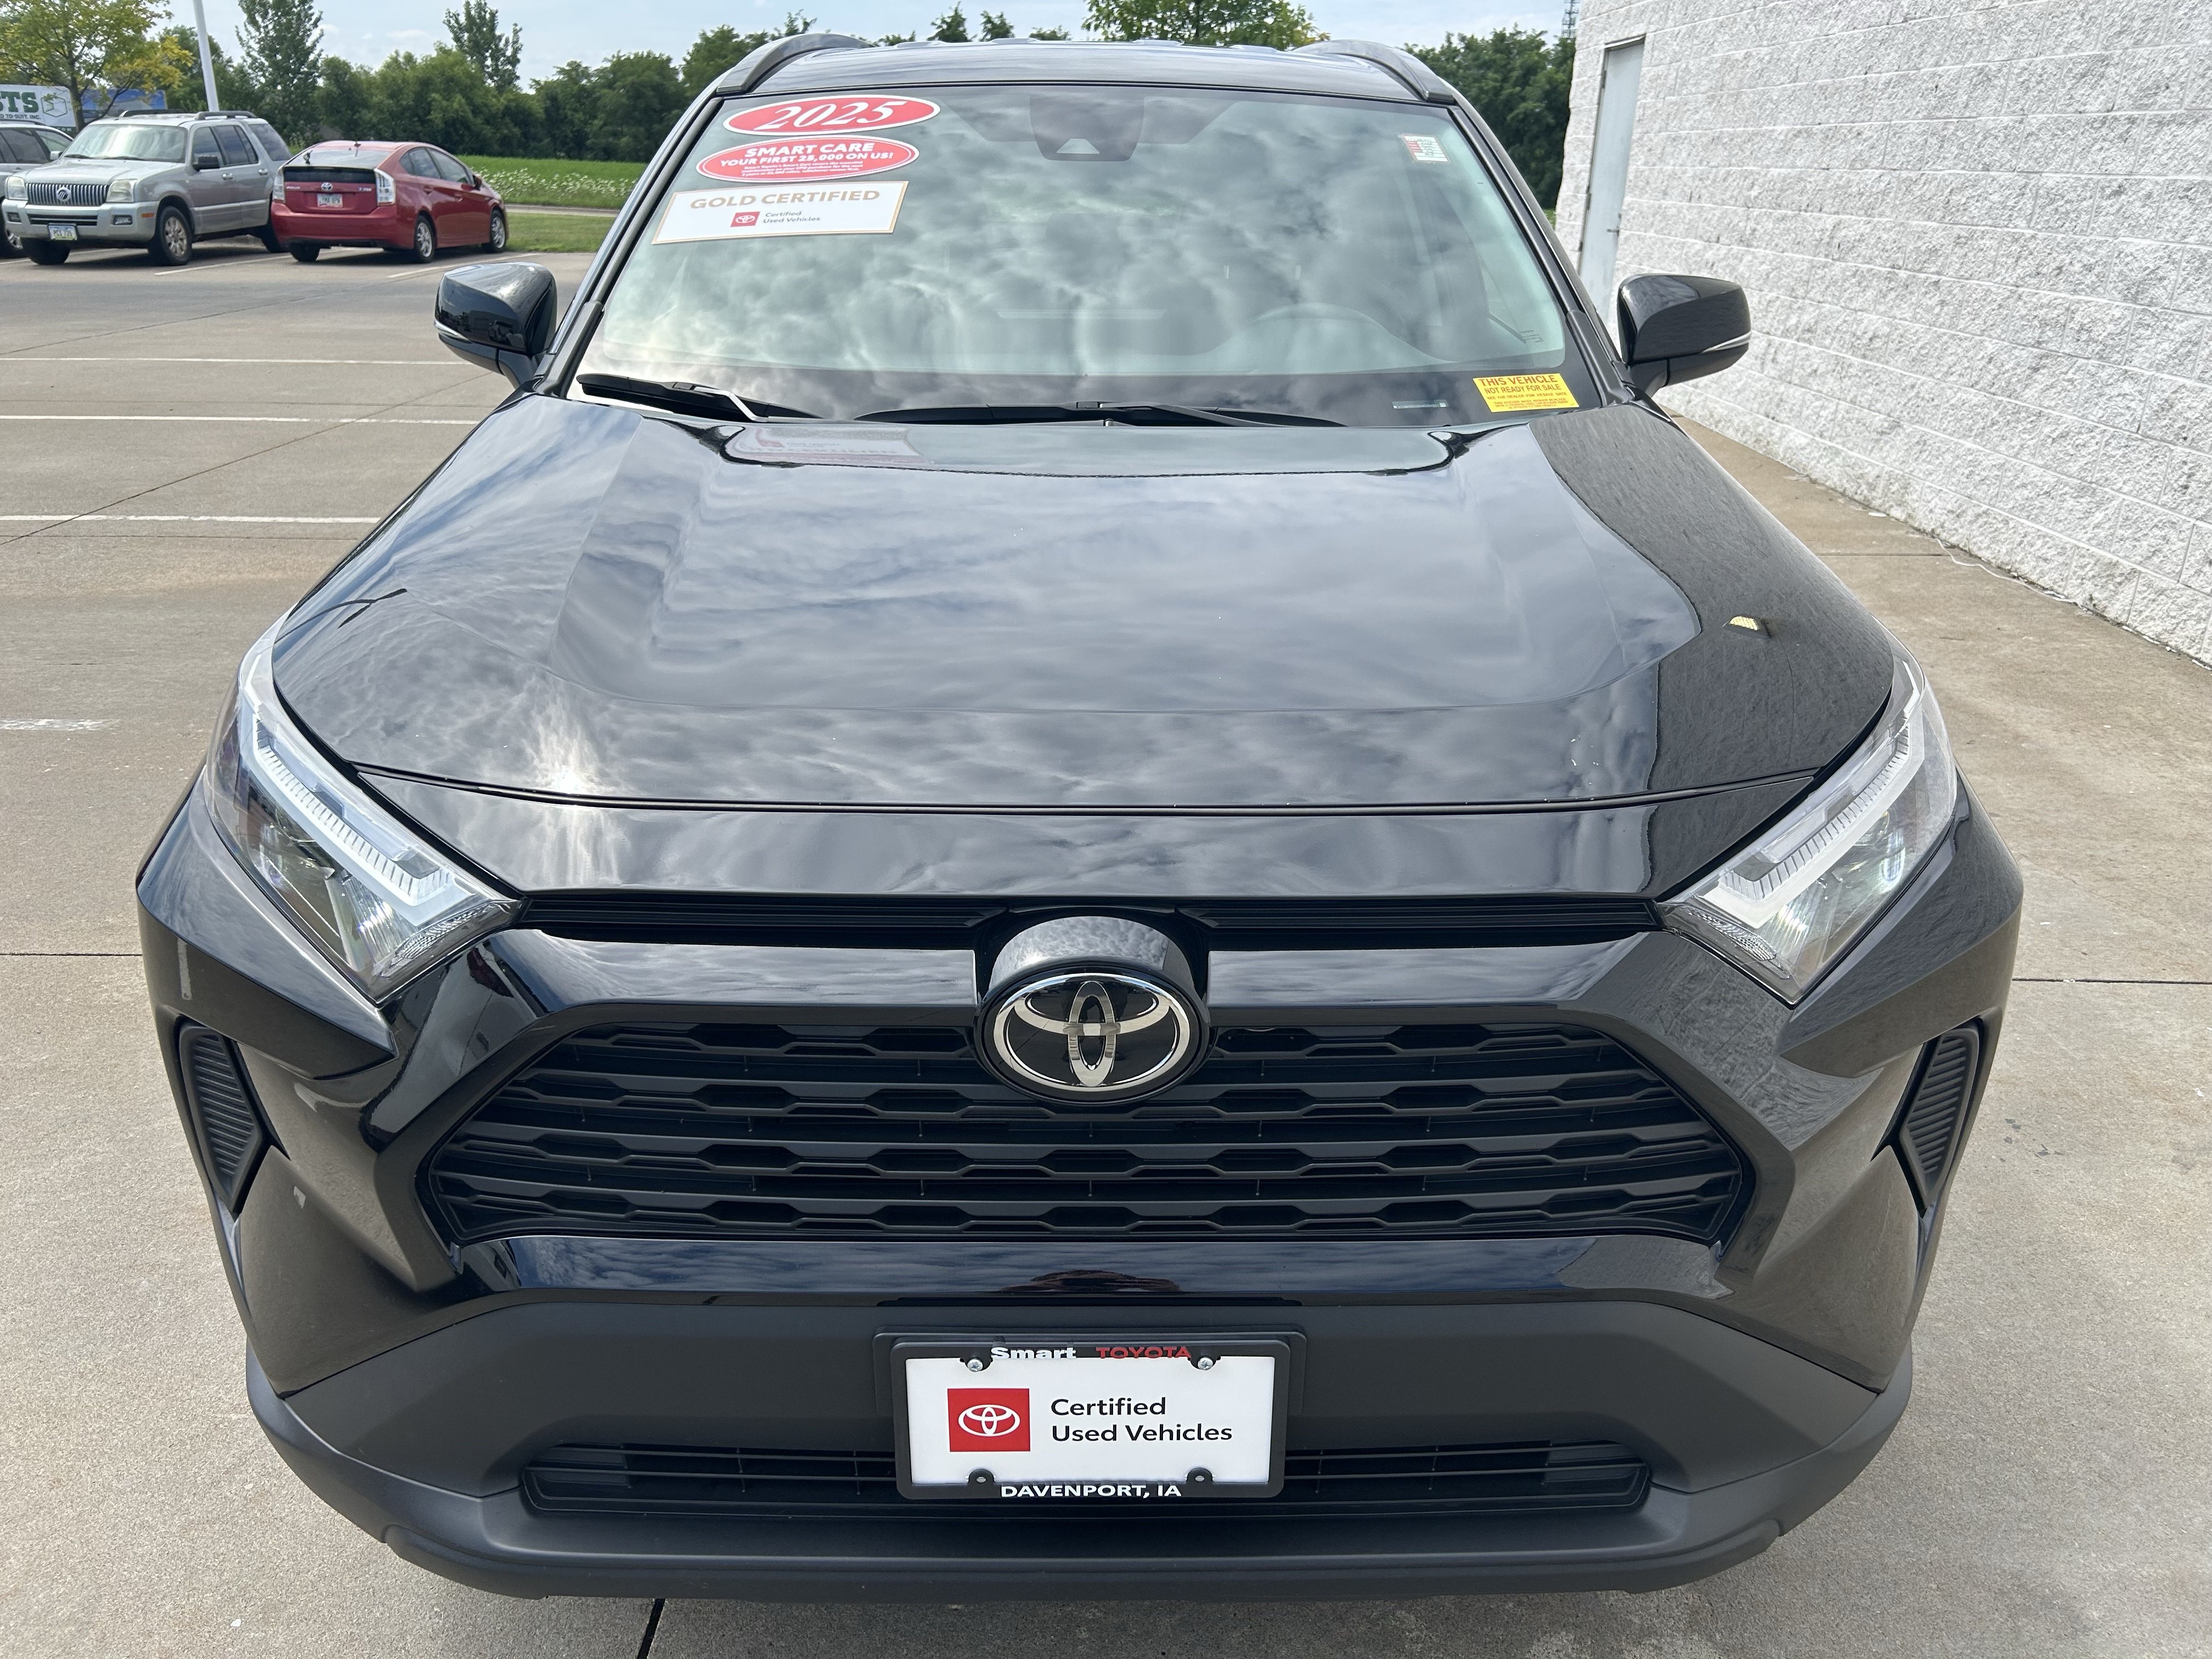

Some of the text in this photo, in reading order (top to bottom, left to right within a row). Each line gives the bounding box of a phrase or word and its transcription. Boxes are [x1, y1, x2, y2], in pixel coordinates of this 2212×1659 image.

[0, 91, 39, 112] TS
[753, 100, 908, 130] 2025
[744, 143, 875, 157] SMART CARE
[720, 158, 758, 167] YOUR
[759, 156, 797, 164] FIRST
[798, 154, 844, 162] 25,000
[690, 190, 881, 208] GOLD CERTIFIED
[1479, 375, 1558, 386] THIS VEHICLE
[990, 1346, 1192, 1359] Smart TOYOTA
[1051, 1397, 1166, 1415] Certified
[1052, 1423, 1232, 1441] Used Vehicles
[1001, 1485, 1182, 1499] DAVENPORT, IA
